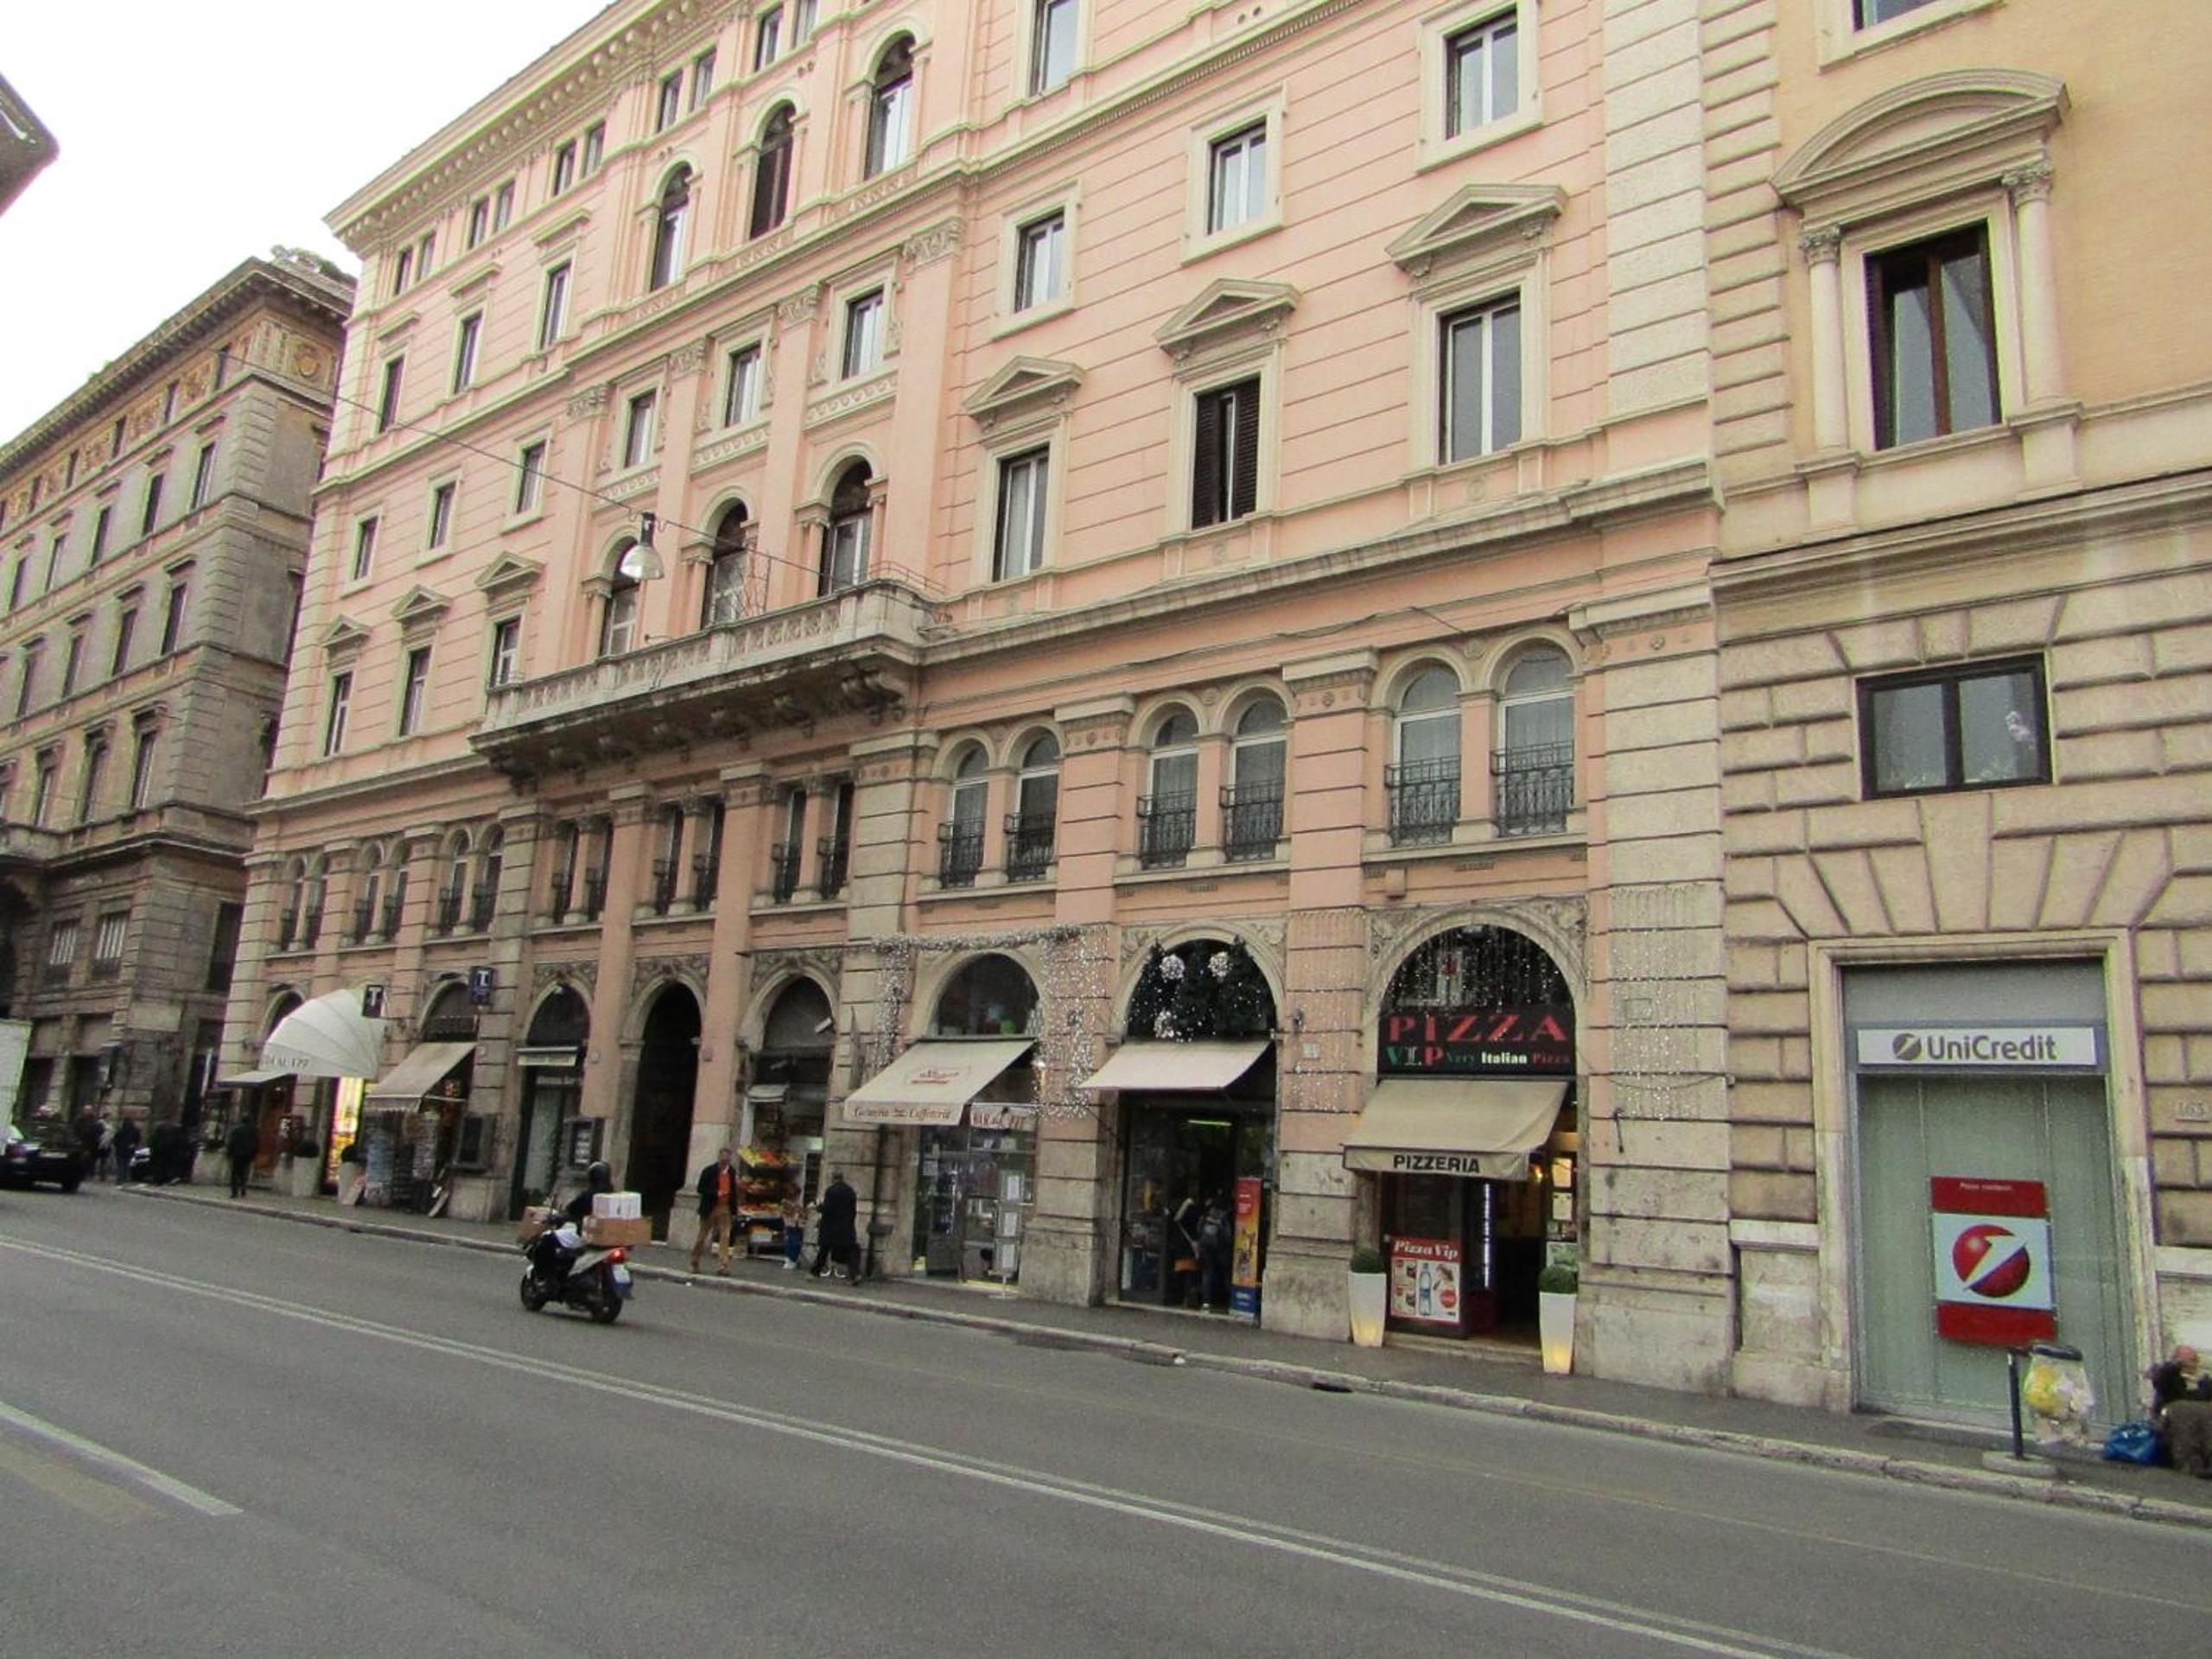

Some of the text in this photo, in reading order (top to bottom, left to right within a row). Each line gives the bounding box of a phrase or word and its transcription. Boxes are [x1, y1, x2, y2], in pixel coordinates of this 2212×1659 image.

[1388, 1014, 1566, 1042] PIZZA
[1927, 1035, 2057, 1060] UniCredit
[1481, 1052, 1528, 1065] Italian
[1393, 1154, 1480, 1173] PIZZERIA
[1394, 1240, 1459, 1260] Pizza Vip
